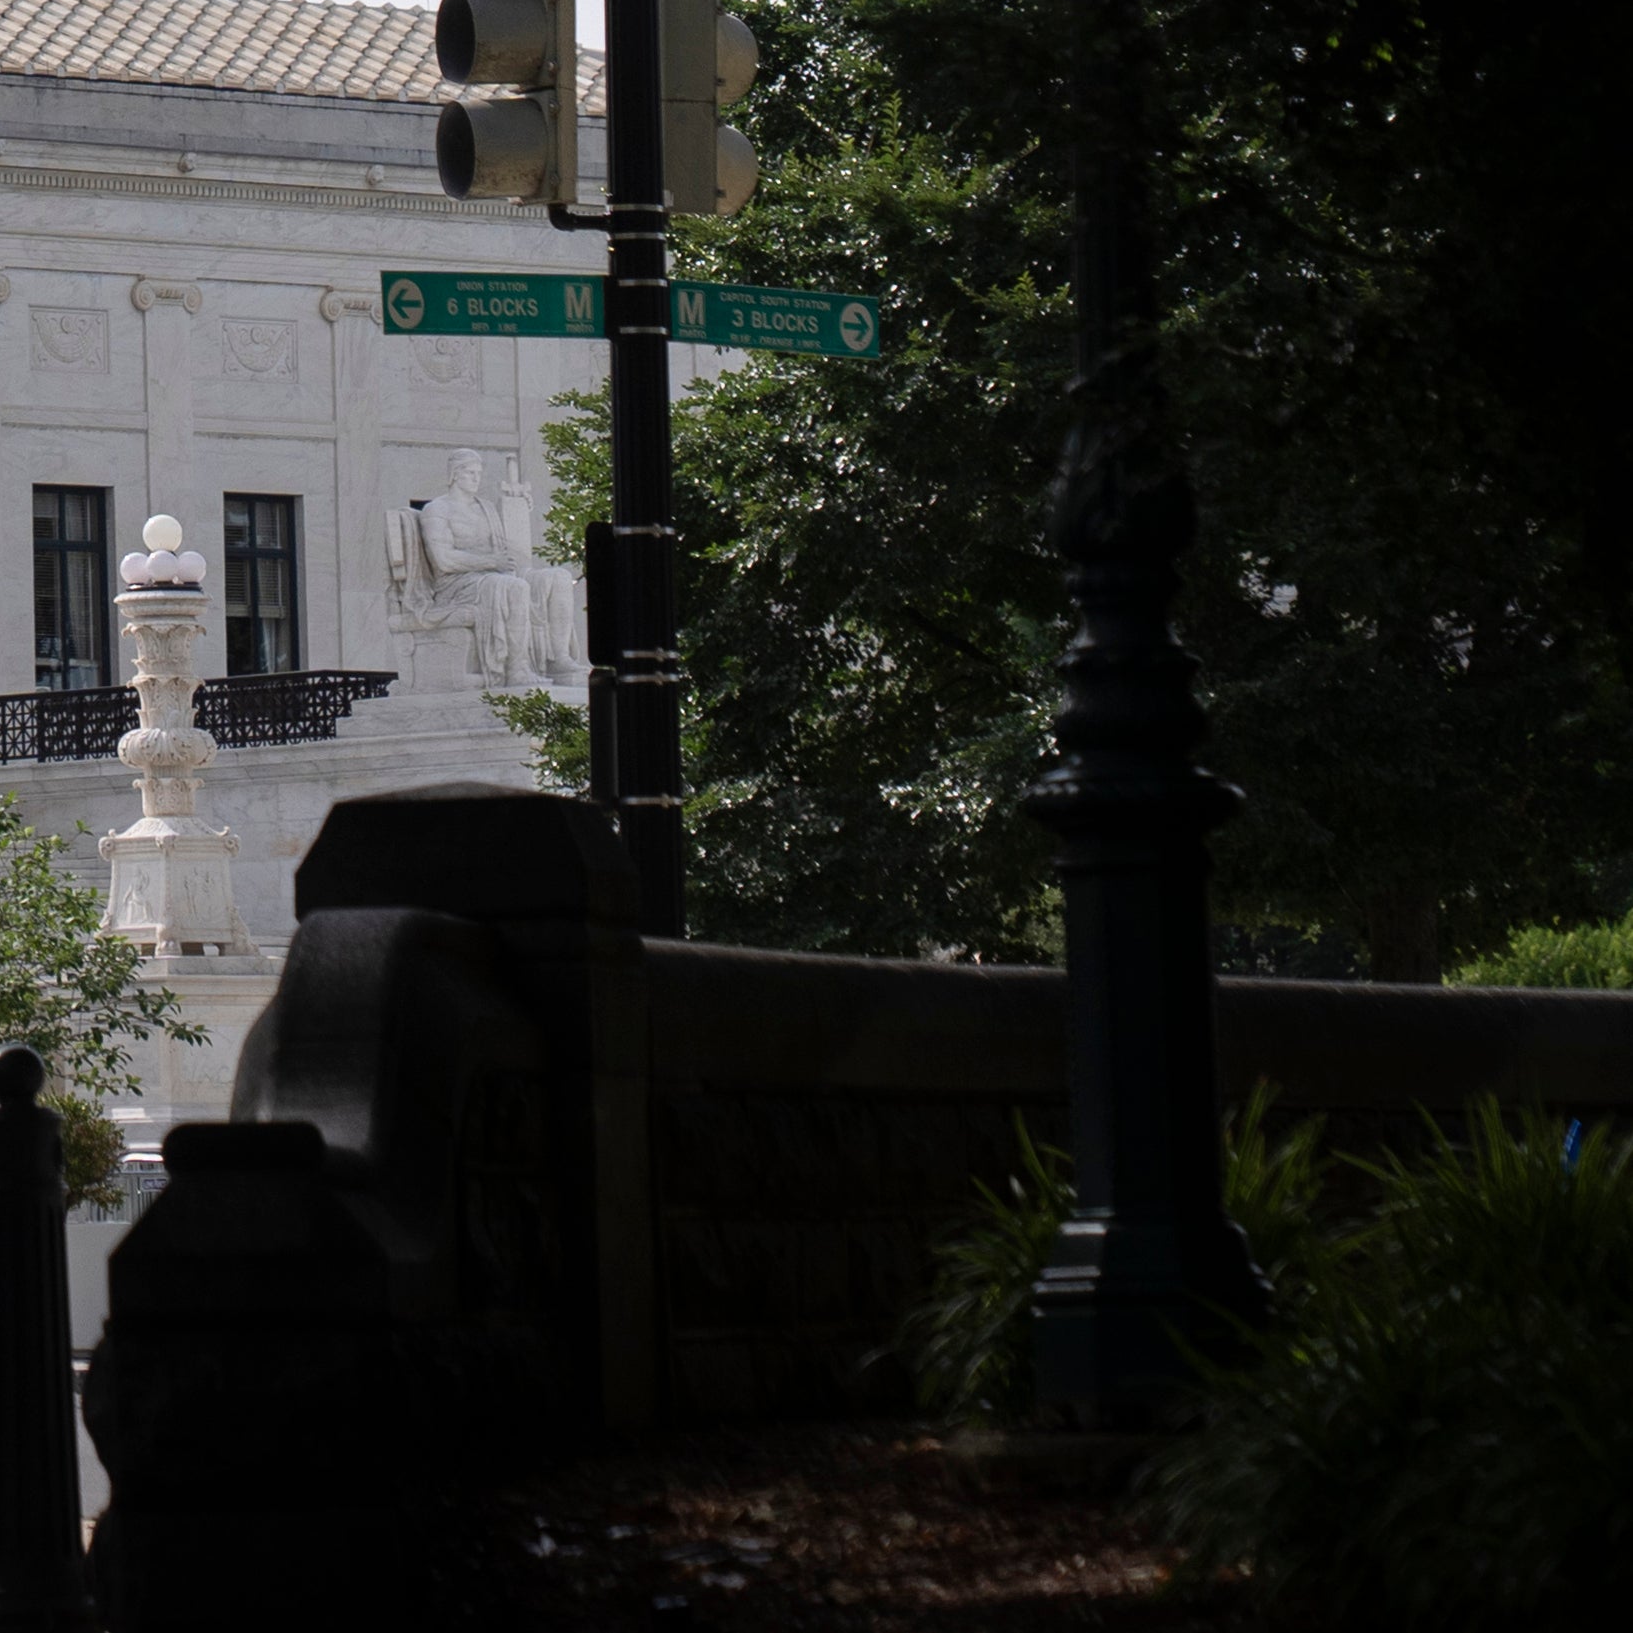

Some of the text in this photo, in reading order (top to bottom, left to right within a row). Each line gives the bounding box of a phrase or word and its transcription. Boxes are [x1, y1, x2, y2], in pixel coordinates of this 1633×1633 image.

[457, 281, 528, 293] UNION STATION
[446, 298, 539, 317] 6 BLOCKS
[565, 284, 593, 320] M
[678, 290, 706, 326] M
[719, 291, 832, 312] CAPITOL SOUTH STATION
[471, 322, 518, 332] RED LINE
[732, 309, 820, 334] 3 BLOCKS
[760, 335, 793, 347] ORANGE
